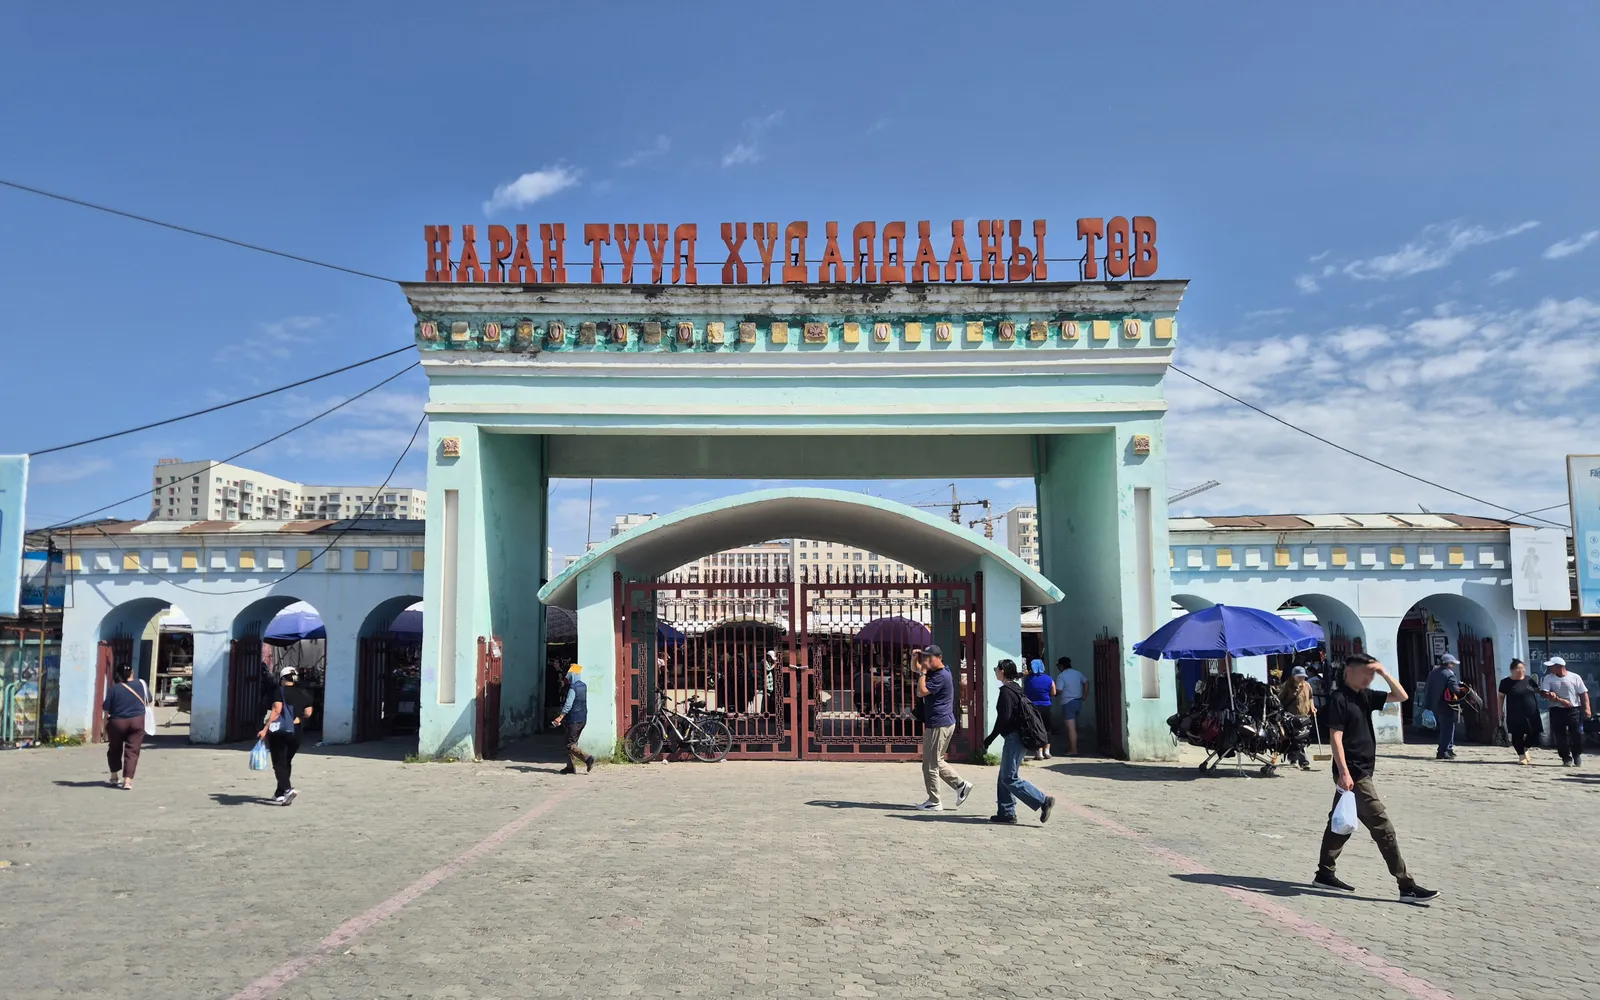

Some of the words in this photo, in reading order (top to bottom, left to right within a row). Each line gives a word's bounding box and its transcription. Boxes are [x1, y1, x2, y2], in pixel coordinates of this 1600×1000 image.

[424, 223, 566, 283] НАРАН
[721, 219, 1047, 285] ХУДАЛДААНЫ
[1077, 215, 1159, 278] ТӨВ
